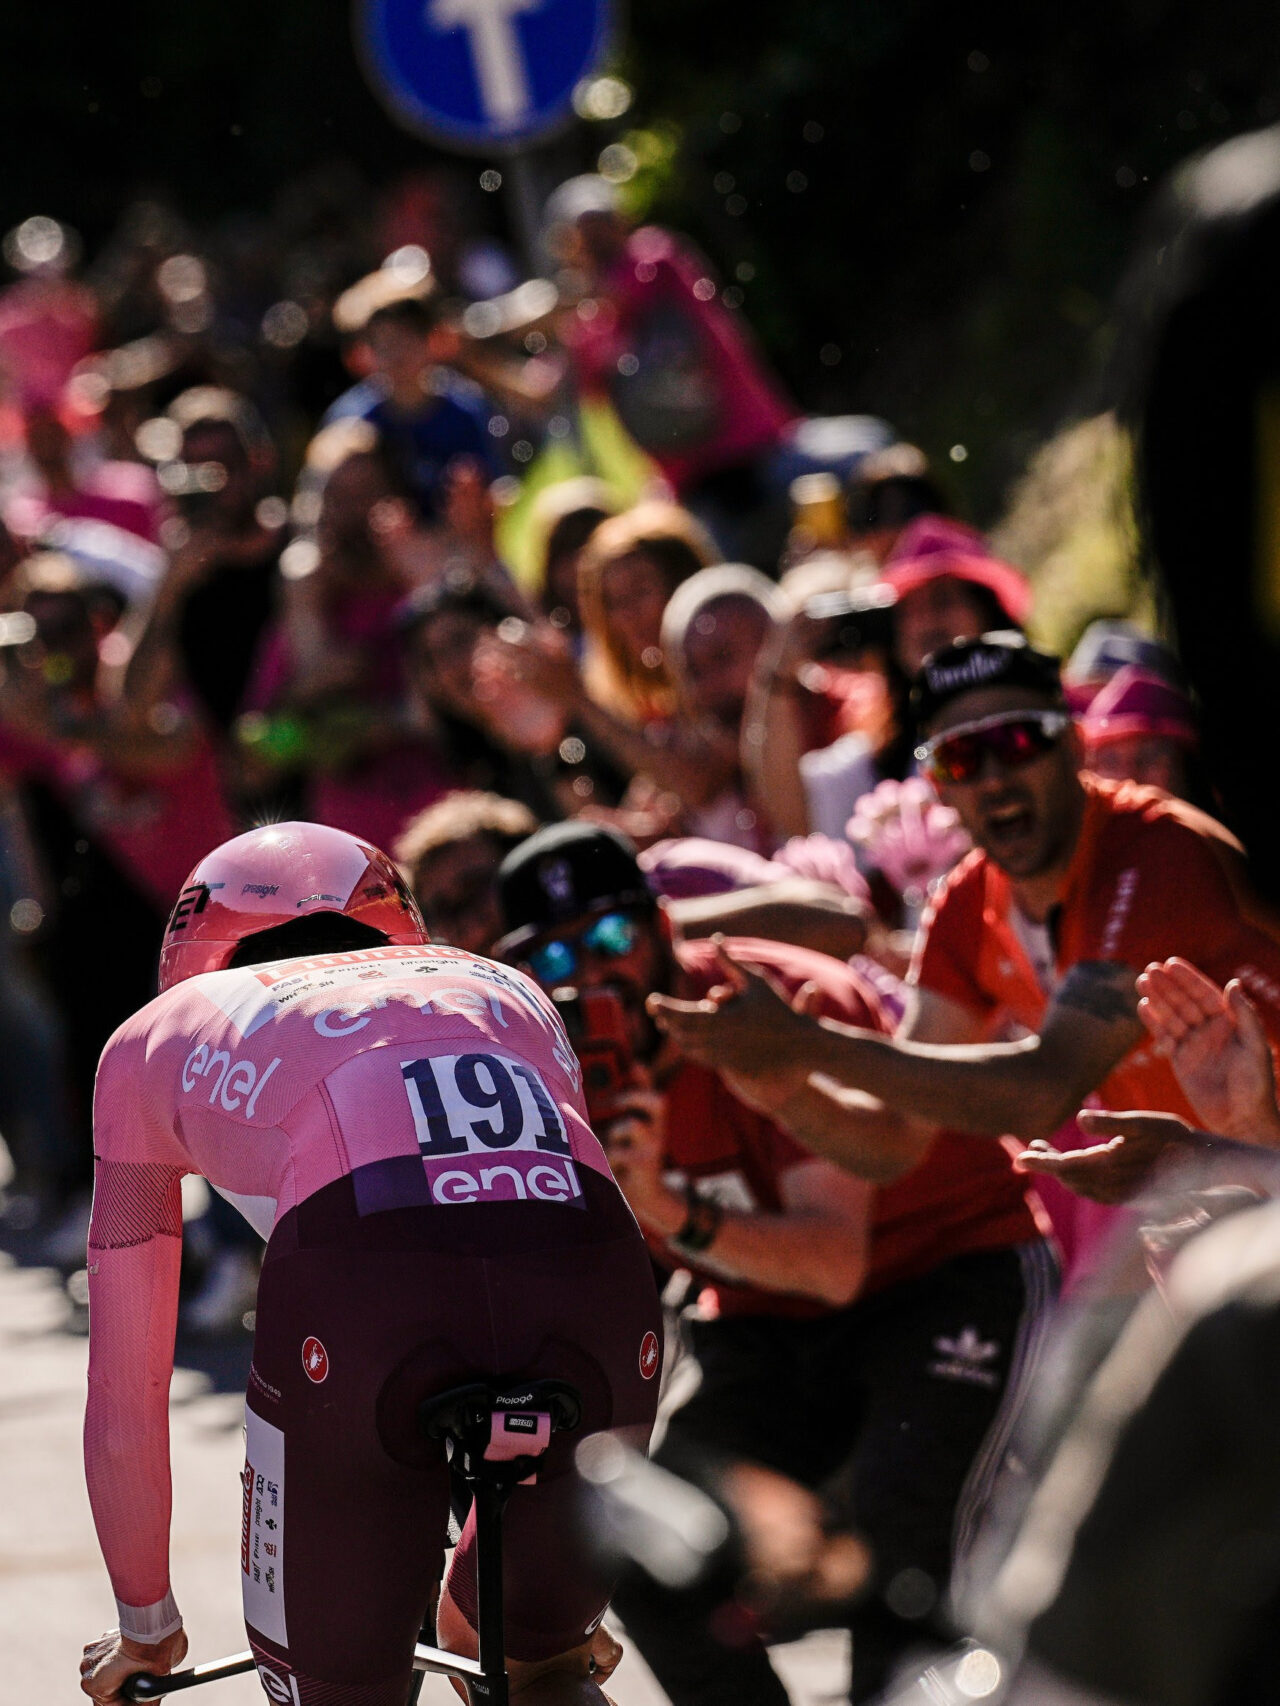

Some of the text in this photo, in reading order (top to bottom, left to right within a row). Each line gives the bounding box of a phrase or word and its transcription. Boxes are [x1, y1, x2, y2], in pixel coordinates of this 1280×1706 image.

[169, 882, 226, 933] ET
[241, 884, 279, 898] presight
[181, 1043, 282, 1120] enel
[402, 1053, 570, 1157] 191
[433, 1161, 582, 1205] enel
[255, 1497, 263, 1528] presight
